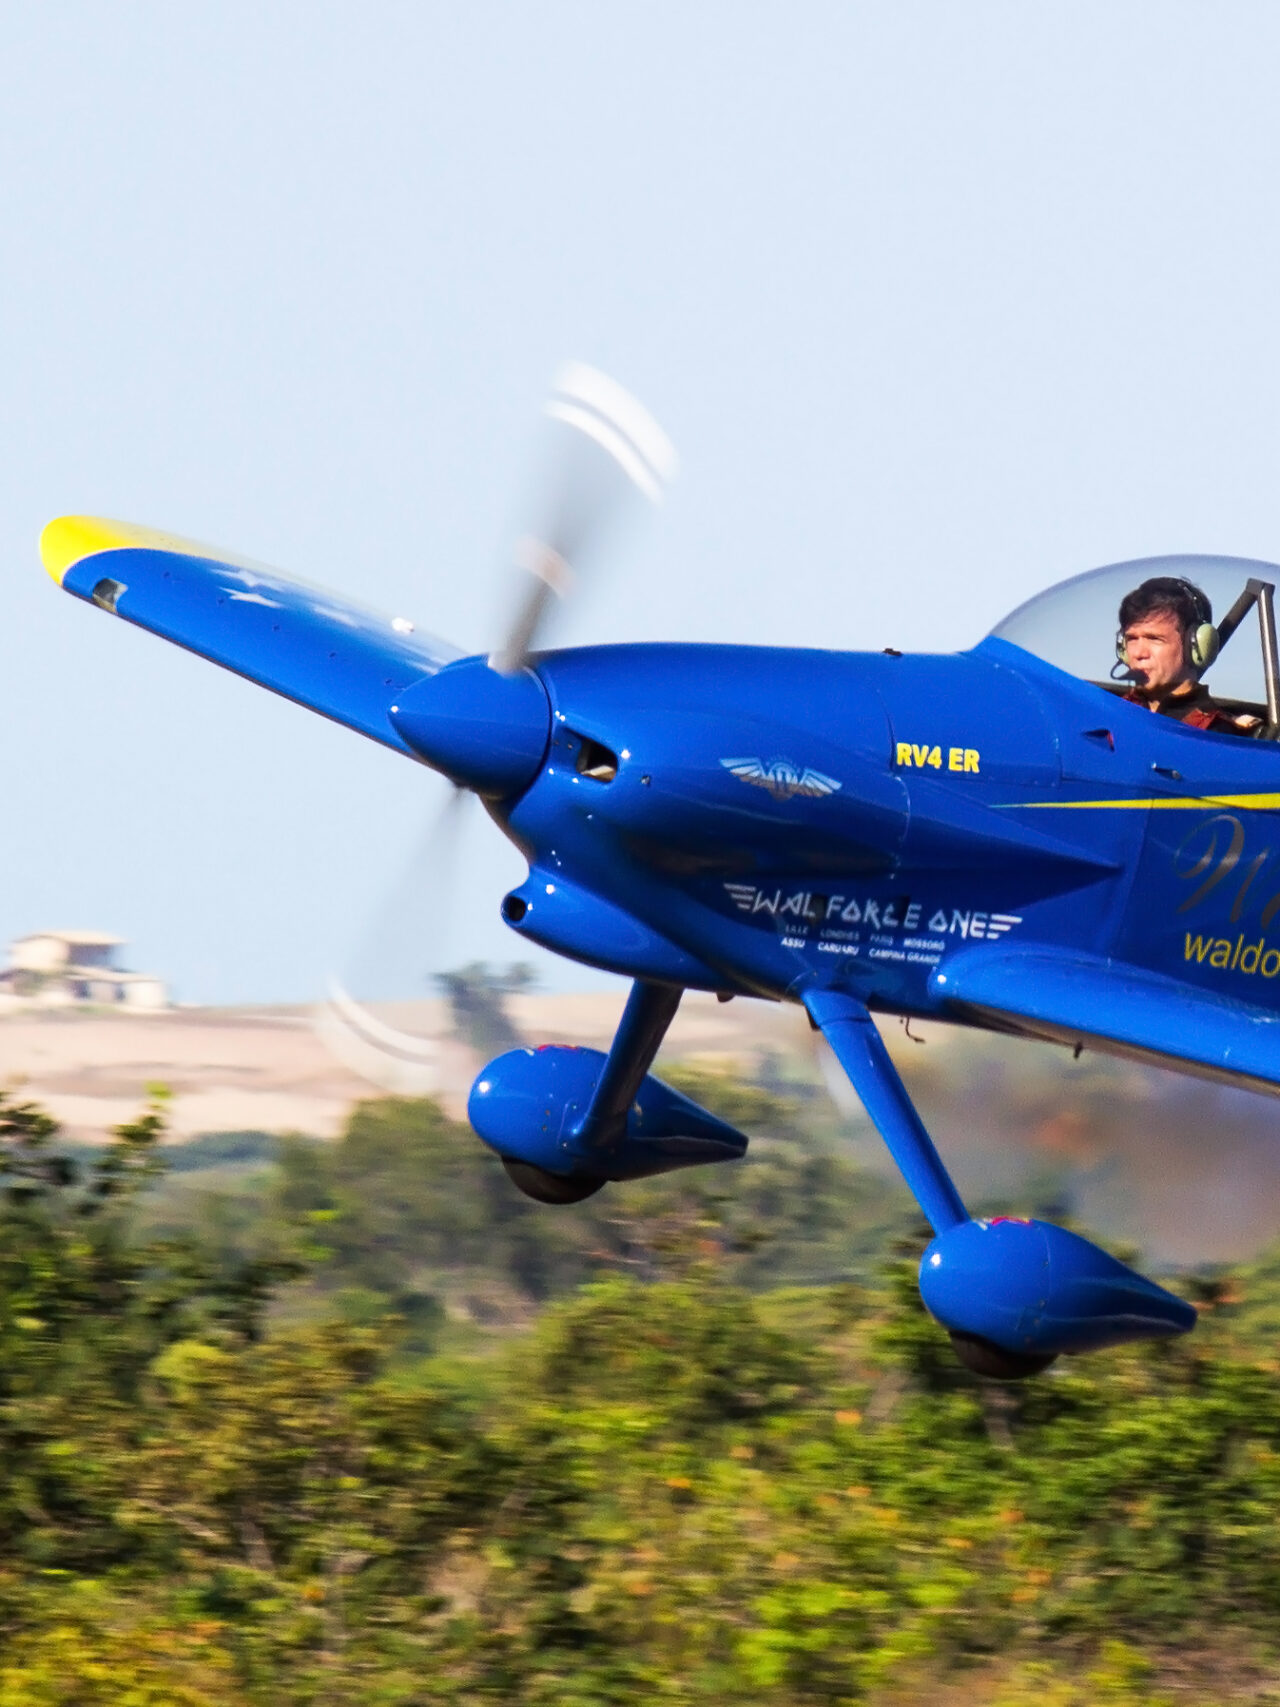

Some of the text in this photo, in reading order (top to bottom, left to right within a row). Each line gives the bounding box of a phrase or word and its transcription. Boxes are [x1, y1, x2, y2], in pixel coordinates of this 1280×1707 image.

[896, 742, 980, 774] RV4 ER
[752, 889, 815, 917] WAL
[826, 895, 922, 930] FORCE
[929, 909, 988, 940] ONE
